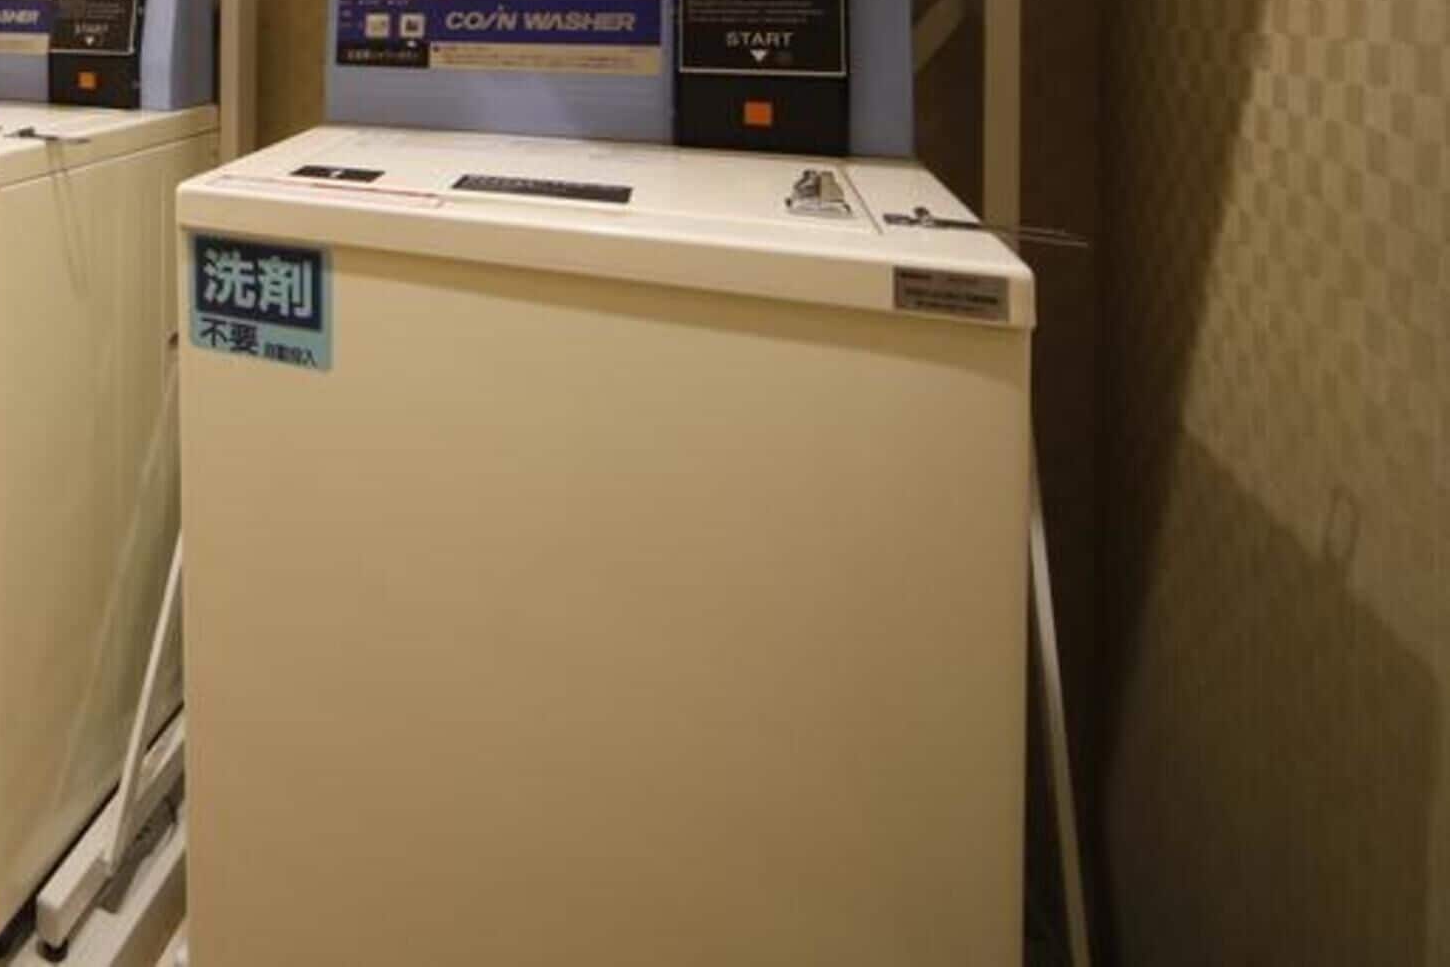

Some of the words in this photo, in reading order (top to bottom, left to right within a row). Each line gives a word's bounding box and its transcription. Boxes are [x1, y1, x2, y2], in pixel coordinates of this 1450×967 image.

[446, 5, 516, 31] COIN
[524, 12, 635, 31] WASHER
[726, 31, 793, 47] START
[203, 249, 313, 317] 洗剤
[200, 317, 259, 354] 不要
